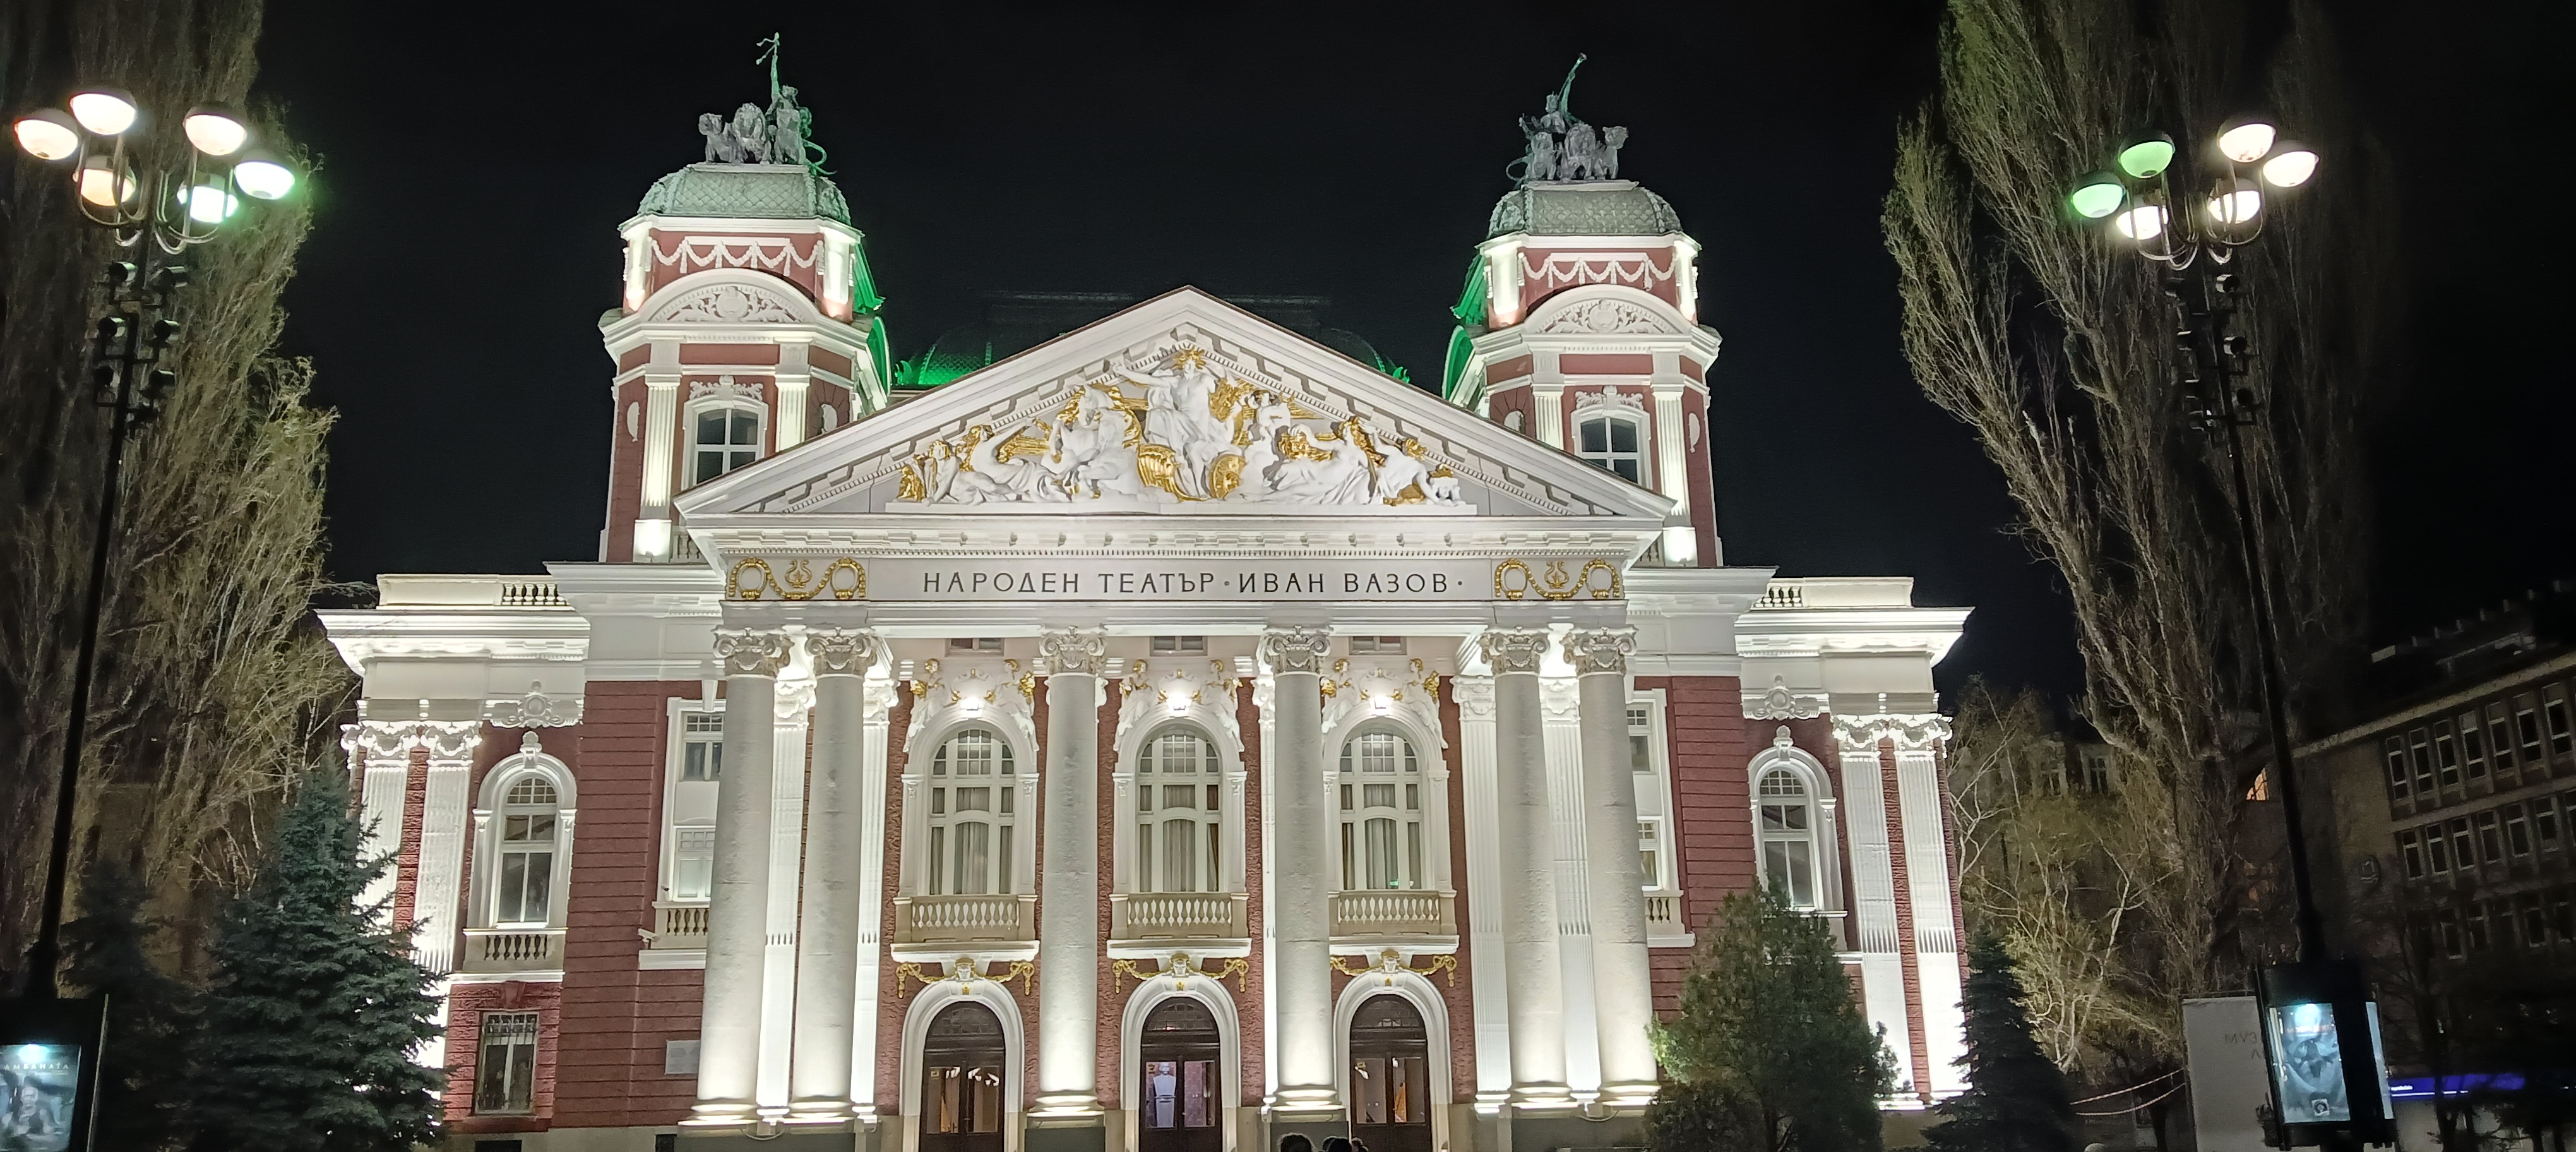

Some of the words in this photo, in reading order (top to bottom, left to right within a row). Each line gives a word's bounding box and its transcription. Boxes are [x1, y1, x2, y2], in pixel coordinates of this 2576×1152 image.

[923, 572, 1078, 593] НАРОДЕН
[1097, 572, 1215, 594] ТЕАТЪР
[1239, 572, 1324, 594] ИВАН
[1344, 572, 1448, 594] ВАЗОВ
